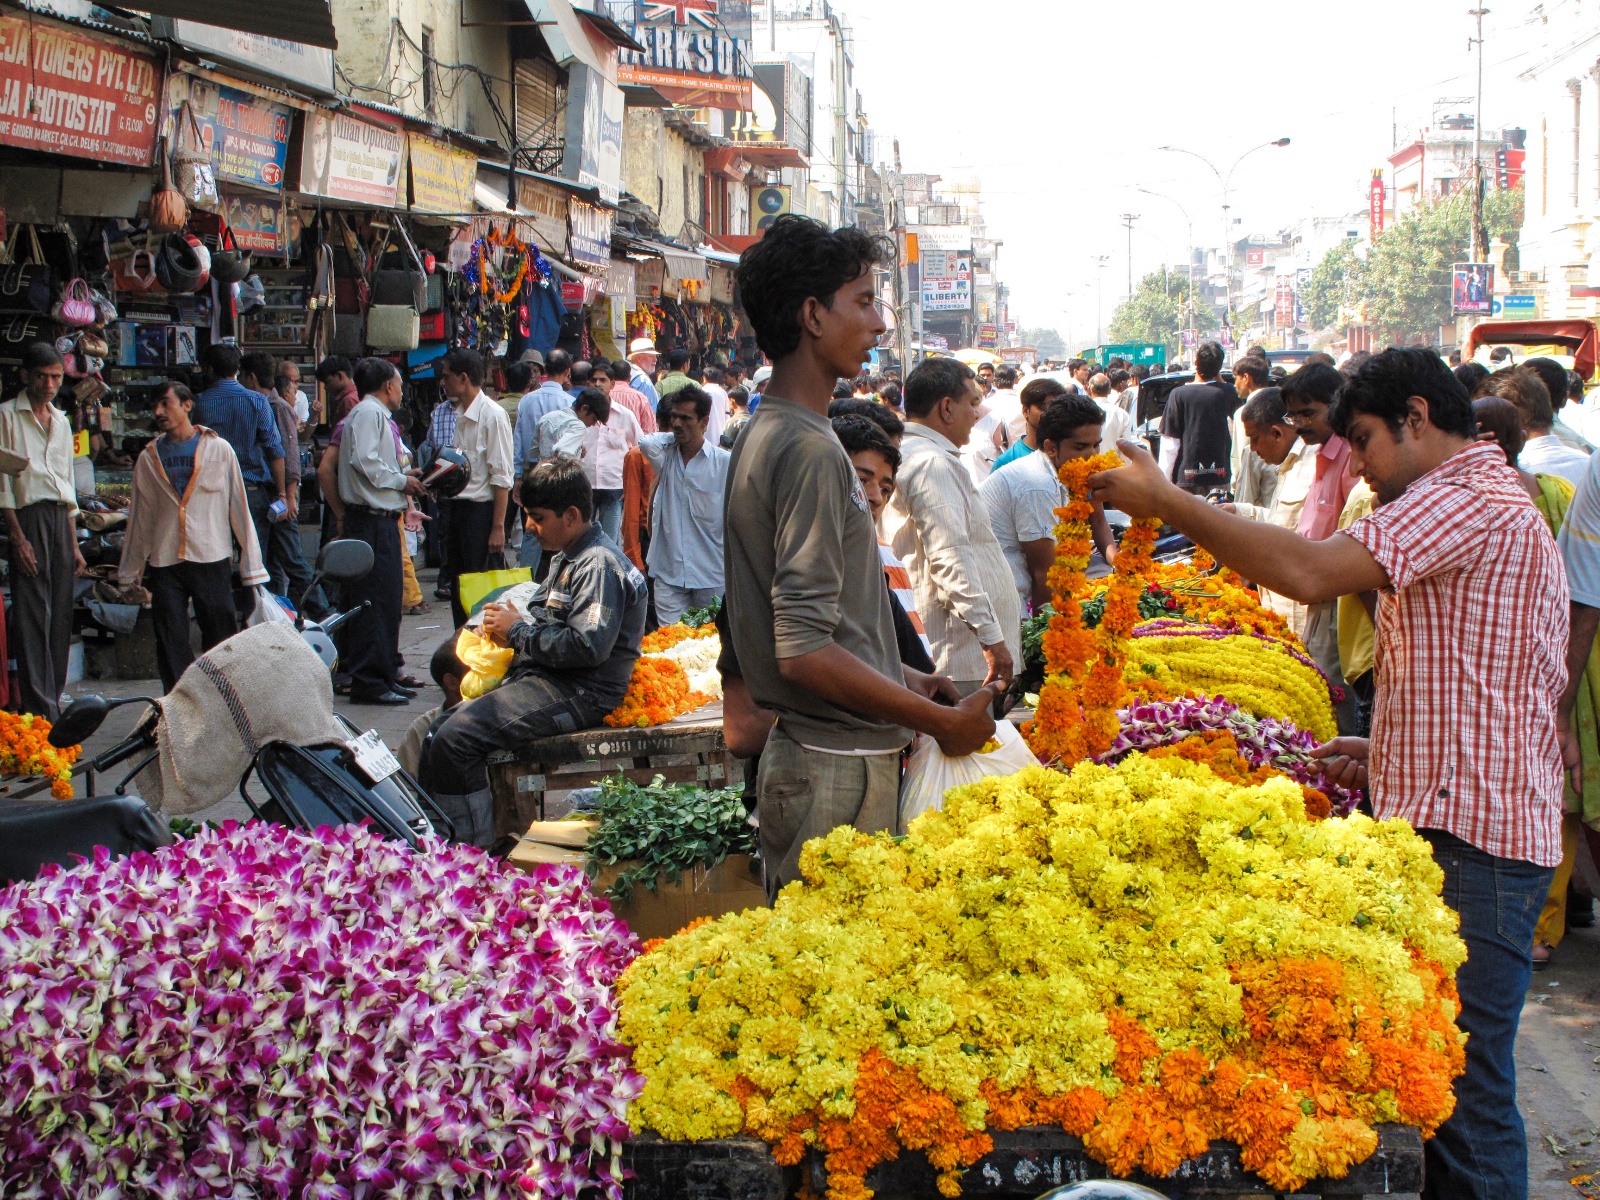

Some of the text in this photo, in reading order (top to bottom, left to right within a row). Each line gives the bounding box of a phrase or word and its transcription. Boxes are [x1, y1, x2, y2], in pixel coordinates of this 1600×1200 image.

[34, 32, 96, 82] TONERS
[96, 50, 126, 91] PVT.
[126, 58, 155, 99] LTD.
[638, 74, 651, 83] DVD
[651, 76, 677, 85] PLAYERS
[681, 80, 698, 88] HOME
[699, 81, 724, 91] THEATRE
[23, 82, 117, 137] PHOTOSTAT
[216, 97, 287, 144] PAL TRADING CO.
[11, 123, 33, 139] GARDEN
[333, 114, 402, 154] Milan Opticians
[251, 142, 276, 159] DOWNLOAD
[274, 168, 279, 183] 6
[571, 199, 611, 245] PHILIPS
[958, 262, 968, 271] A
[929, 293, 969, 301] LIBERTY
